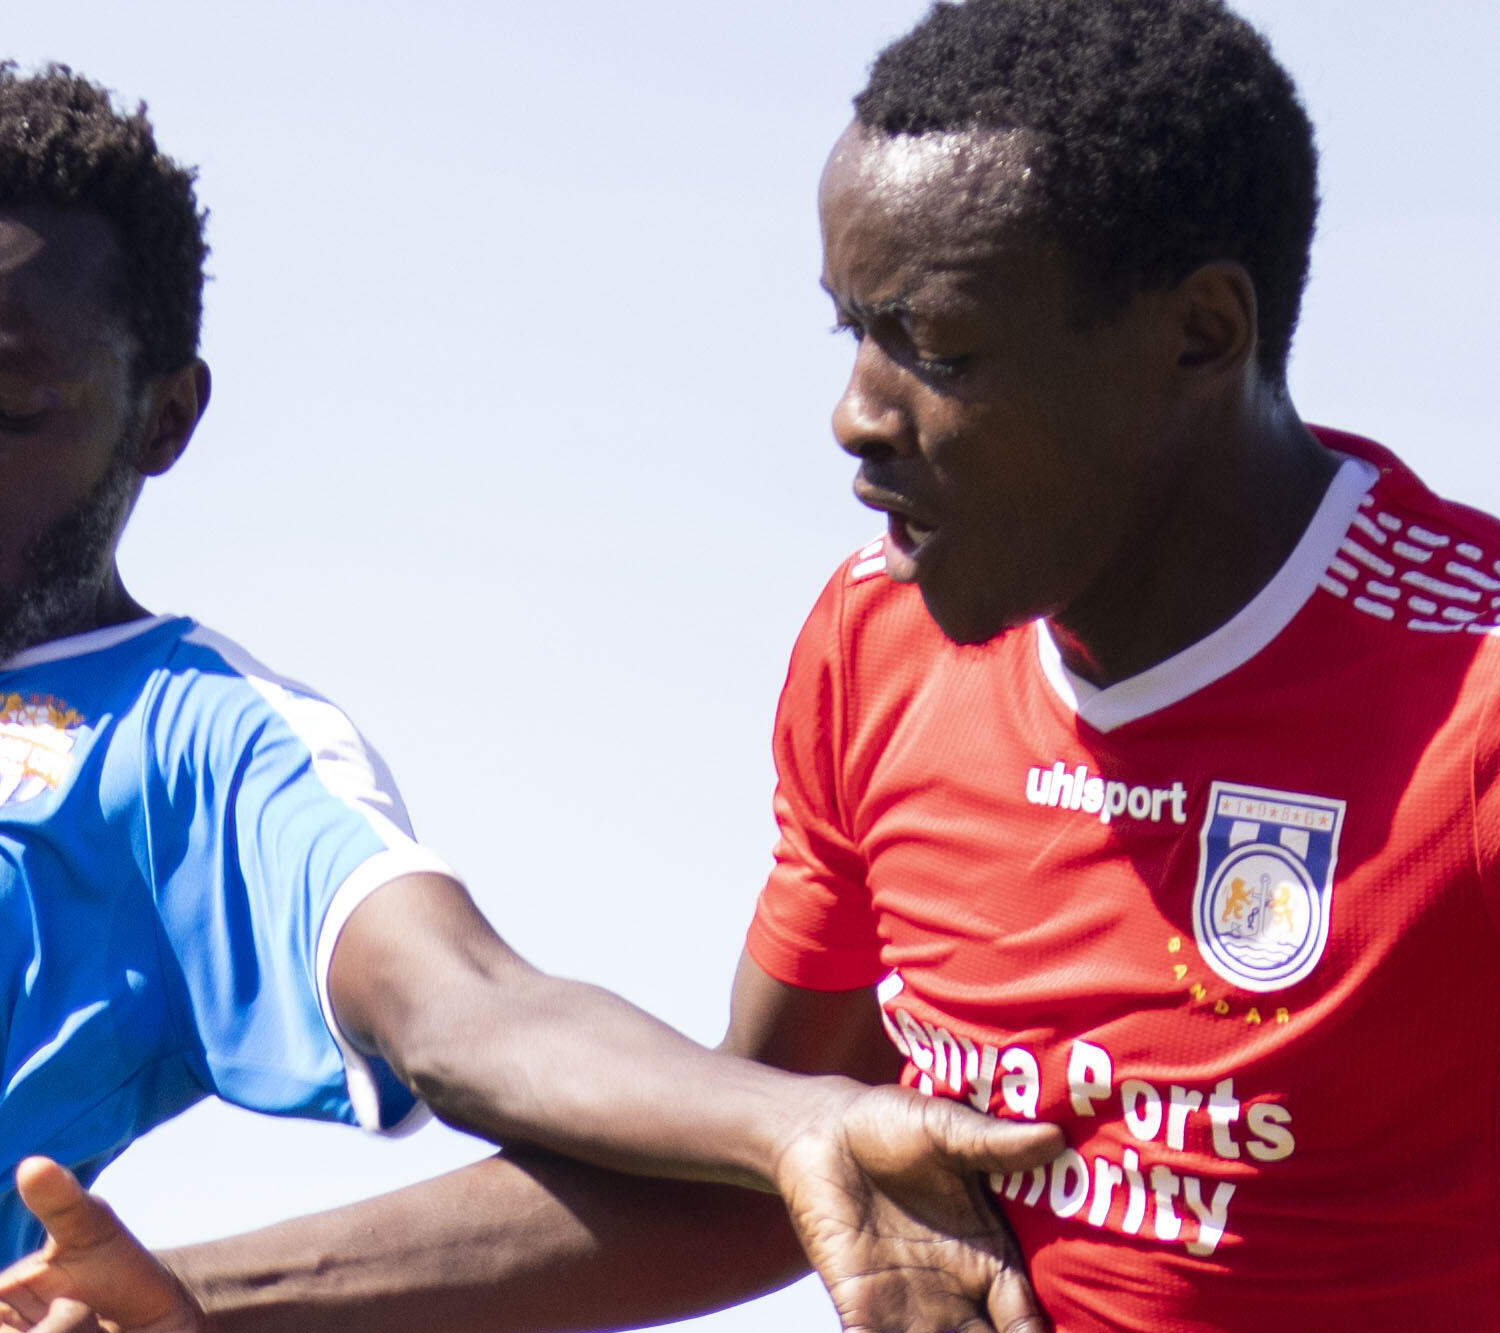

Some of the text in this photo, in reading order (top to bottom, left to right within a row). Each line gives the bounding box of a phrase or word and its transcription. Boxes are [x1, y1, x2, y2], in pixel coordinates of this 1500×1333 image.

[1025, 760, 1187, 824] uhlsport
[1167, 936, 1290, 1025] BANDAR
[1067, 1039, 1296, 1161] Ports
